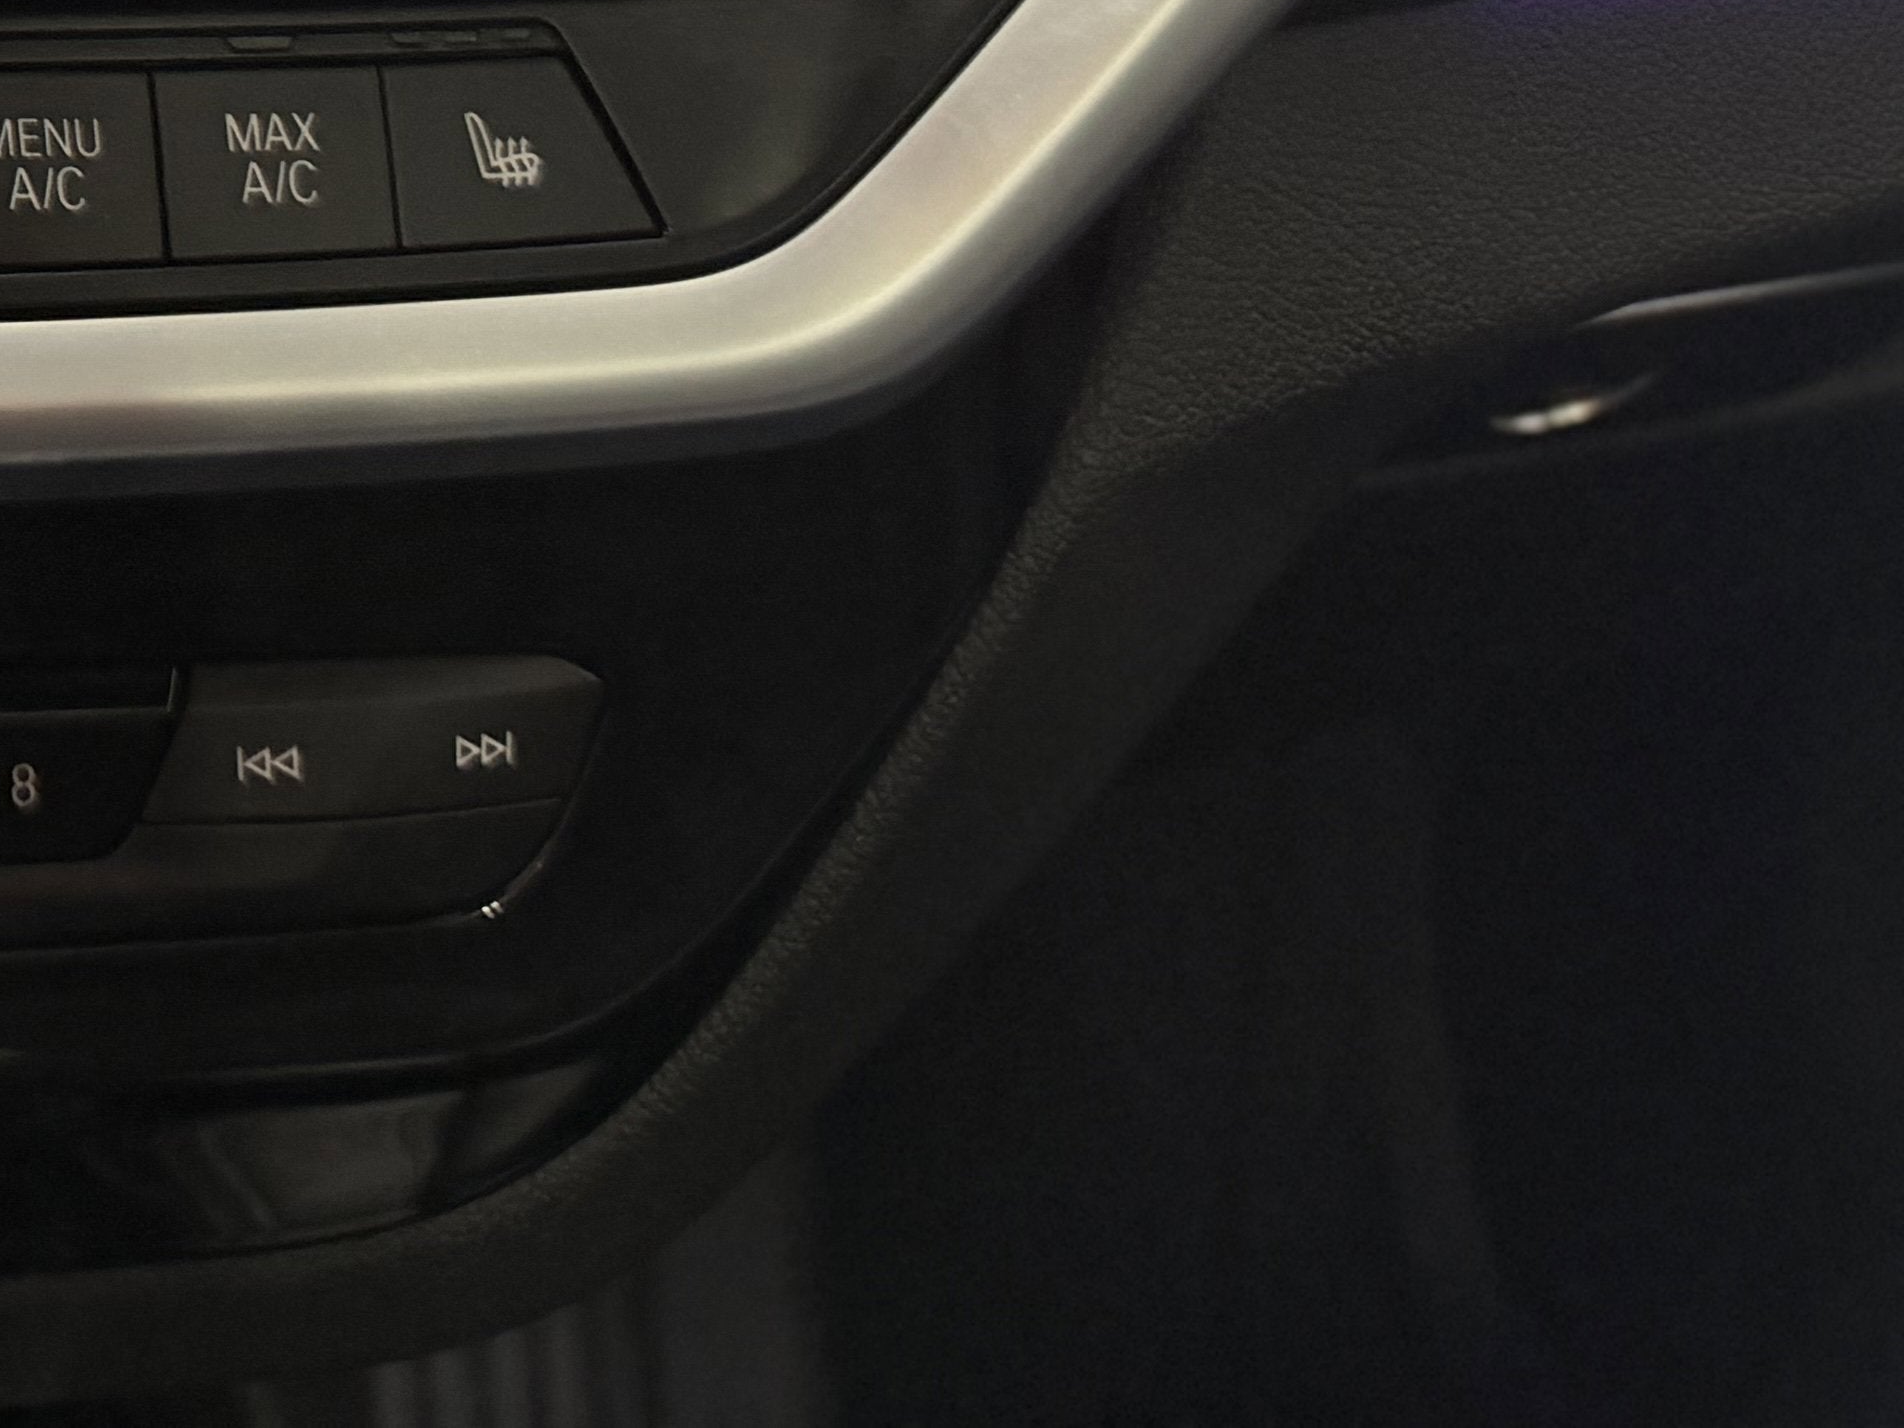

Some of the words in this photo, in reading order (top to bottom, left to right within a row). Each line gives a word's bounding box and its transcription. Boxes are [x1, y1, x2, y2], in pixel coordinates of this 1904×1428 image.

[225, 112, 320, 153] MAX
[9, 168, 85, 211] A/C
[242, 163, 319, 204] A/C
[10, 763, 36, 809] 8
